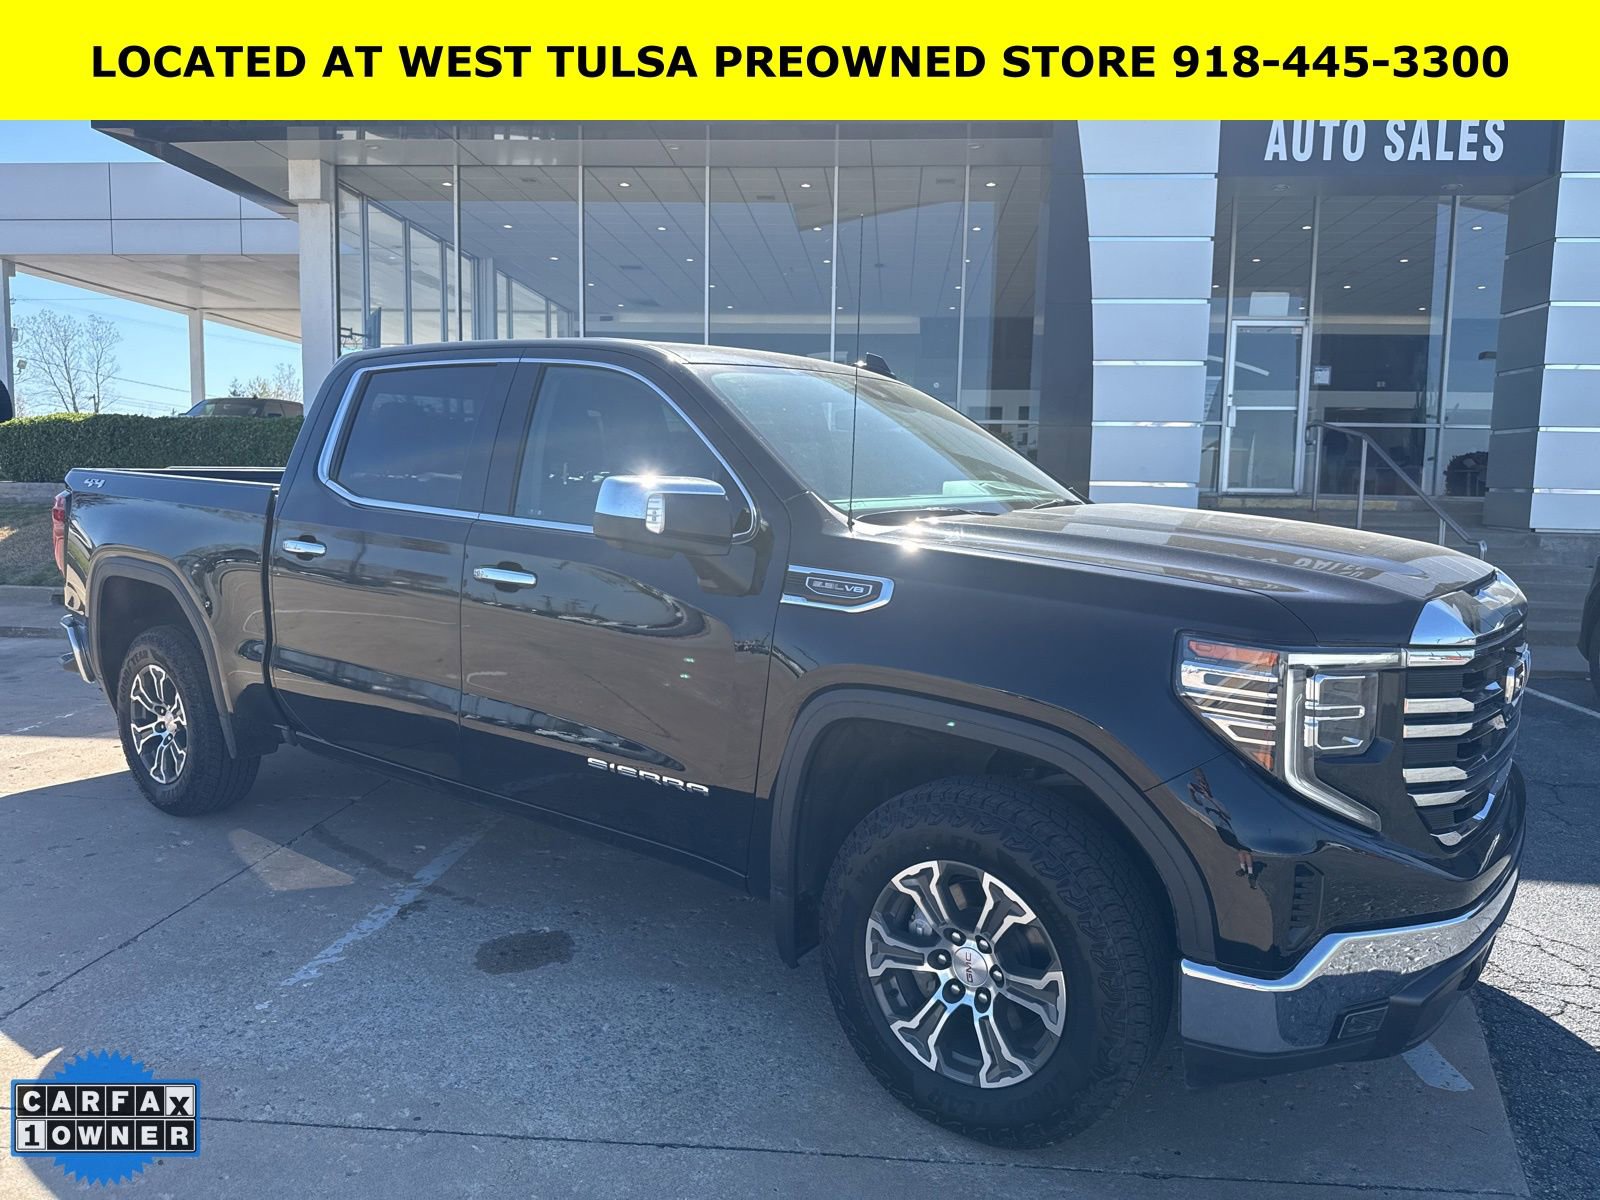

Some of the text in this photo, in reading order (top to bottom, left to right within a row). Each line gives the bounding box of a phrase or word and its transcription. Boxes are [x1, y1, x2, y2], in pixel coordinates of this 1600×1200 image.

[1264, 120, 1506, 162] AUTO SALES
[587, 757, 709, 797] SIERRA
[965, 951, 974, 984] GMC
